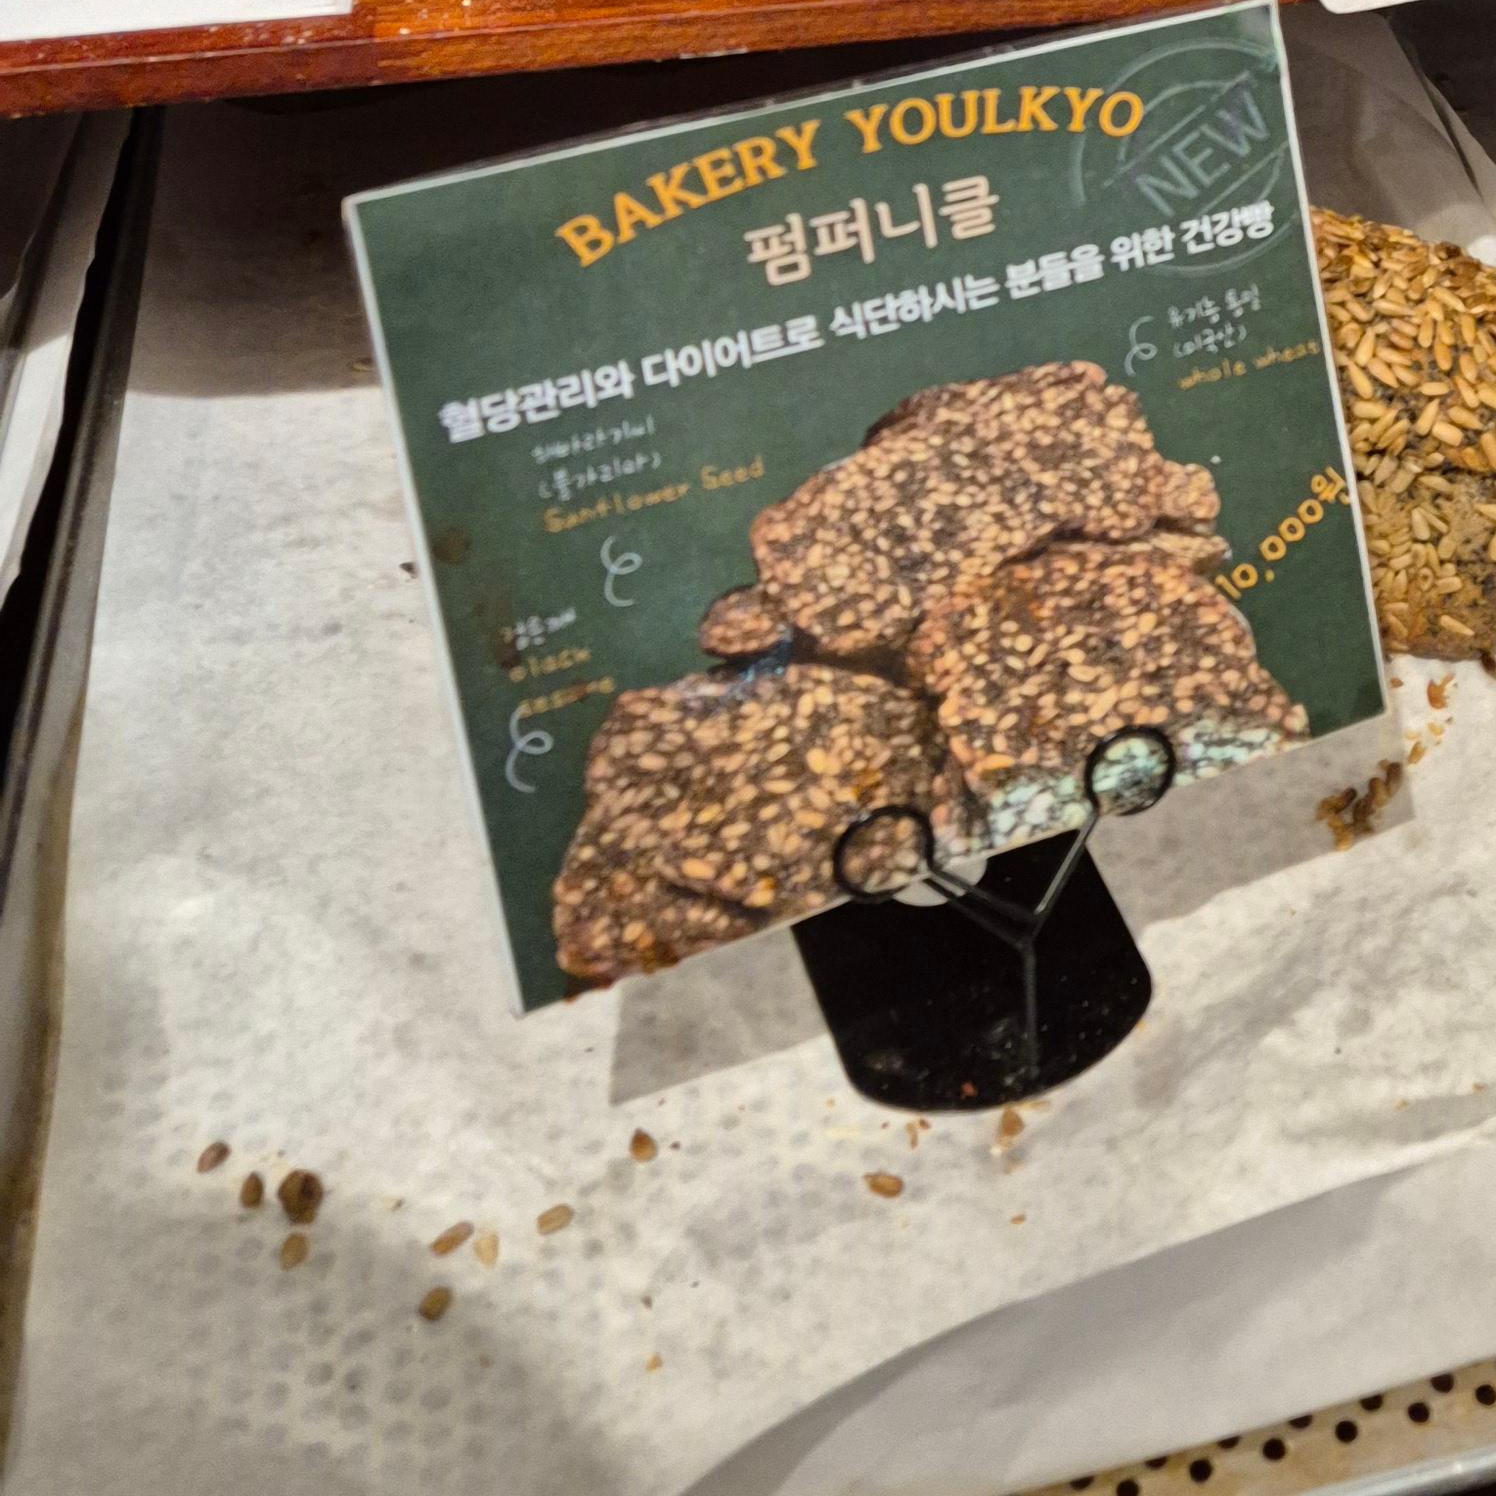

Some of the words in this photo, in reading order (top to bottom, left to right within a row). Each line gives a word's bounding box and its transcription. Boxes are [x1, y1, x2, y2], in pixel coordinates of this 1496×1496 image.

[555, 119, 821, 268] BAKERY
[844, 86, 1145, 154] YOULKYO
[1135, 91, 1270, 218] NEW
[743, 175, 1000, 286] 펌퍼니클
[438, 359, 637, 444] 혈당관리와
[641, 314, 827, 388] 다이어트로
[829, 274, 1000, 340] 식단하시는
[1005, 243, 1105, 301] 분들을
[1110, 225, 1176, 272] 위한
[1180, 199, 1277, 255] 건강빵
[1215, 466, 1351, 600] 10,000원
